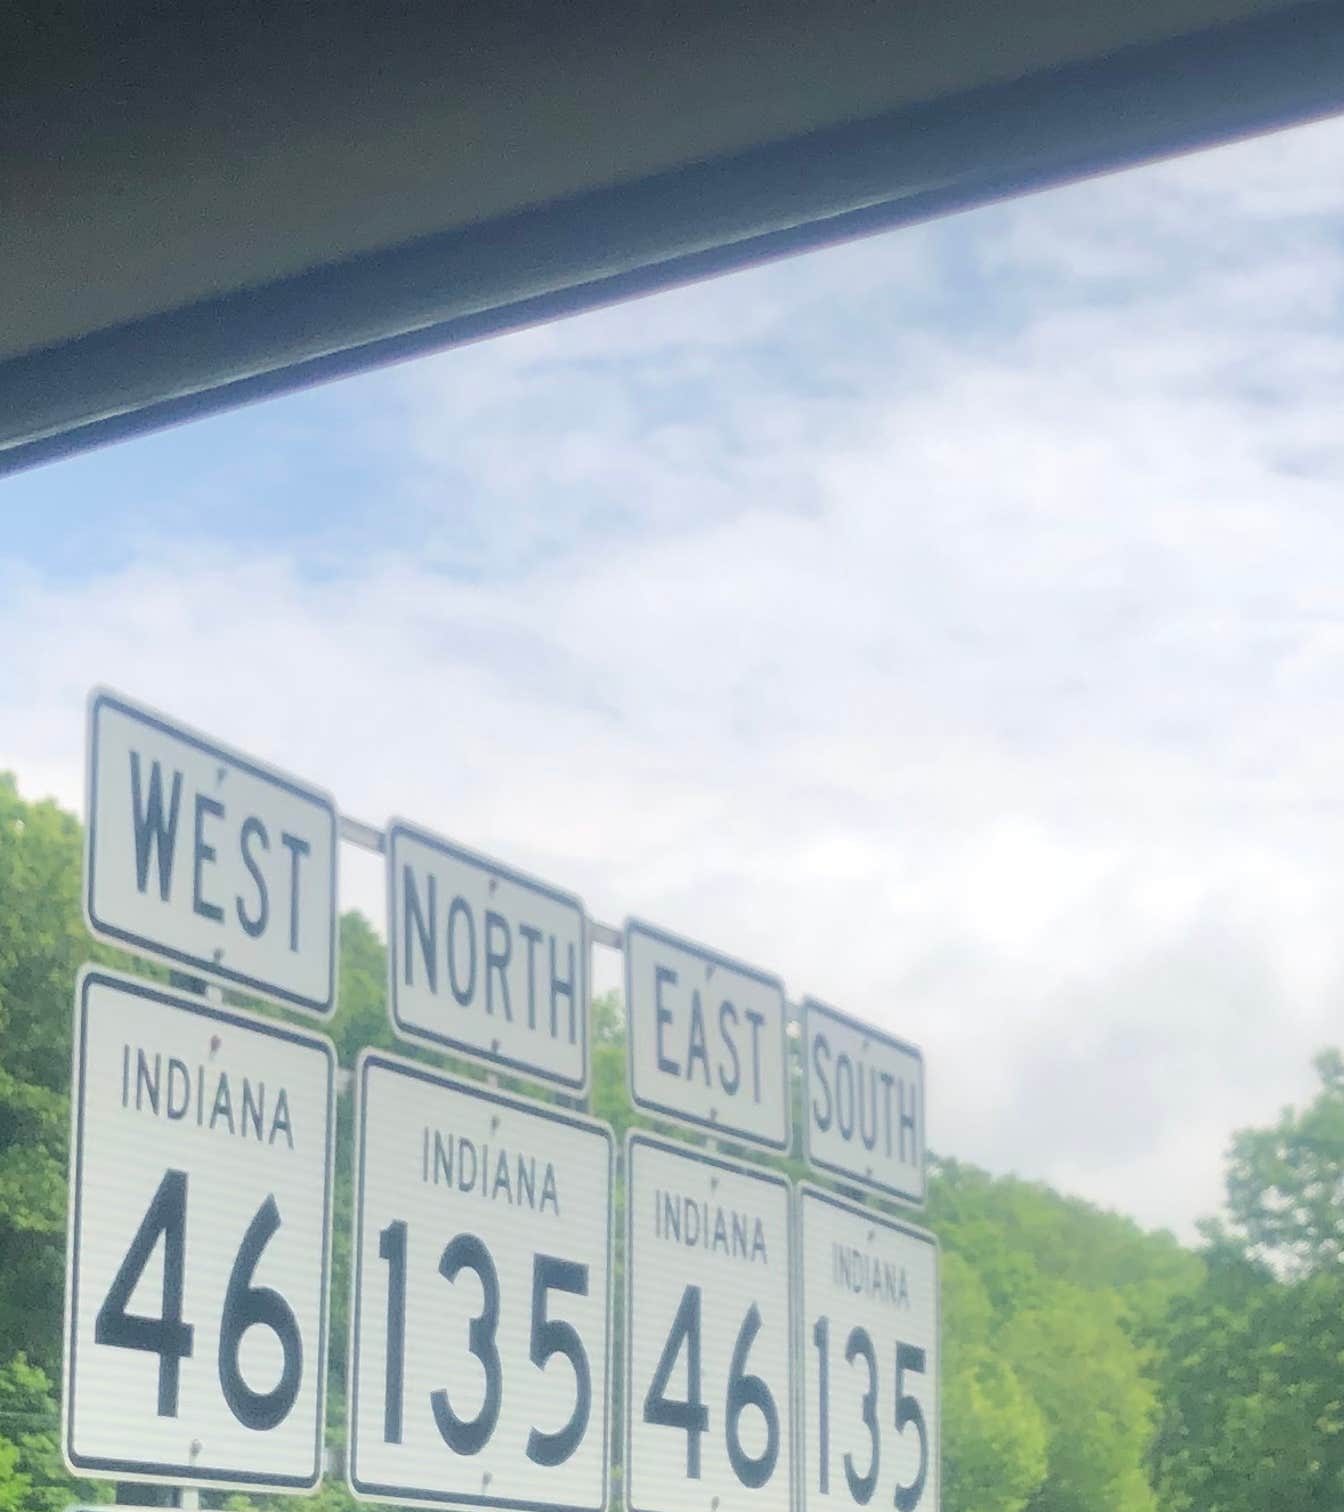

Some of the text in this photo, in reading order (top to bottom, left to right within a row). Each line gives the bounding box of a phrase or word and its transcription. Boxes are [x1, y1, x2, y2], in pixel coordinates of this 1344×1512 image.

[129, 749, 311, 952] WEST
[402, 863, 577, 1045] NORTH
[122, 1045, 294, 1150] INDIANA
[654, 964, 765, 1104] EAST
[810, 1032, 917, 1165] SOUTH
[422, 1127, 560, 1218] INDIANA
[654, 1190, 768, 1264] INDIANA
[95, 1169, 304, 1432] 46
[378, 1220, 592, 1467] 135
[832, 1241, 911, 1311] INDIANA
[643, 1285, 781, 1490] 46
